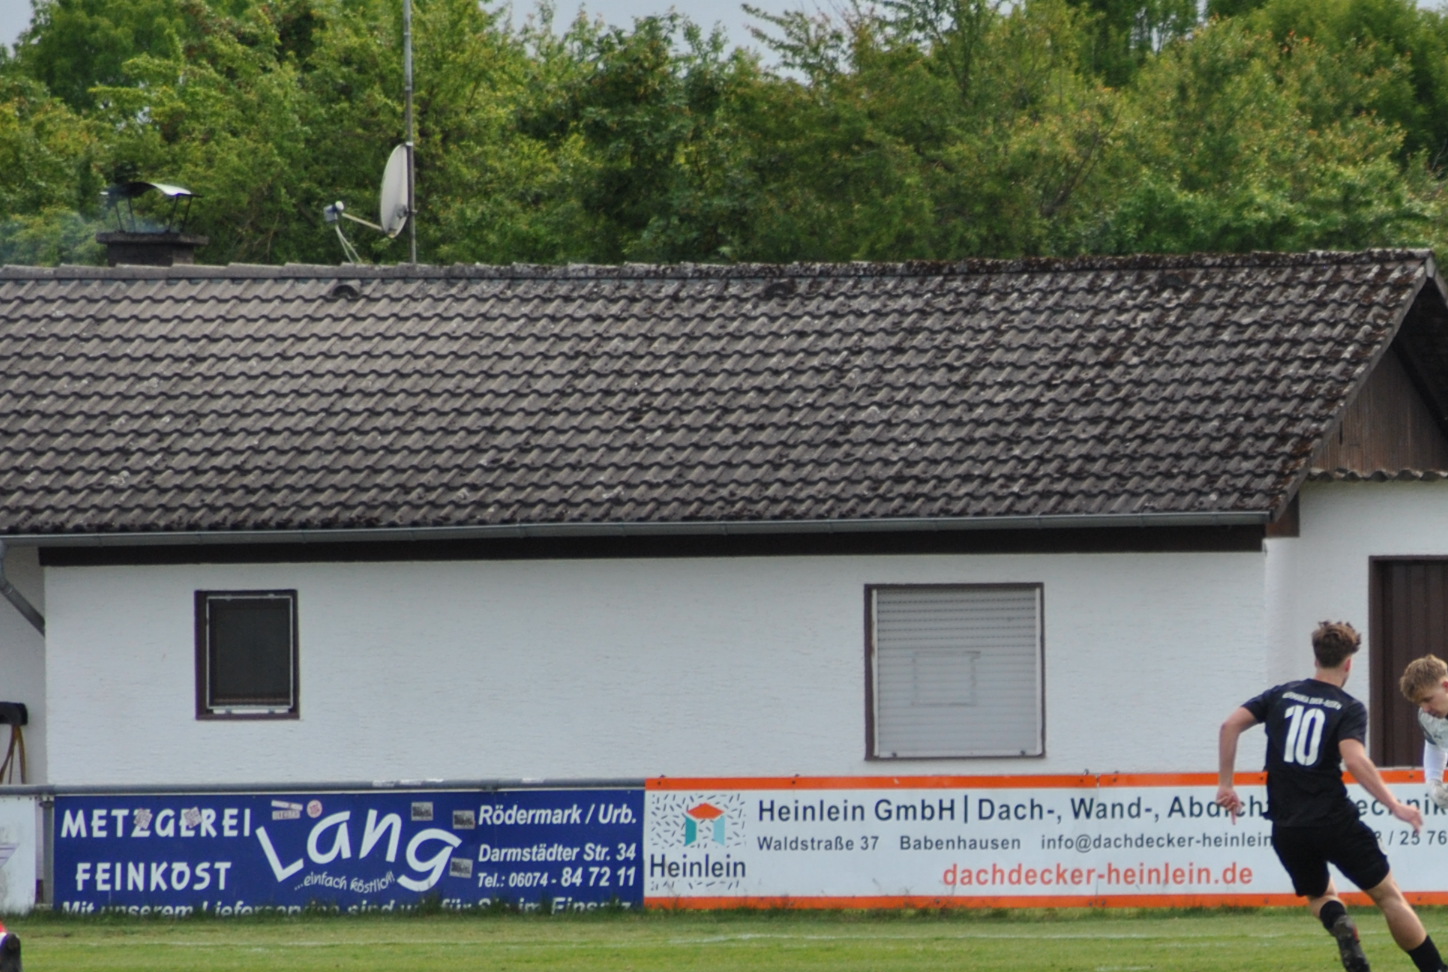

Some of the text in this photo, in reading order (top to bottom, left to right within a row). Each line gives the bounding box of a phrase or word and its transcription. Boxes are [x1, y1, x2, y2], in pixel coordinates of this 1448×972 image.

[1284, 705, 1325, 766] 10
[478, 804, 582, 825] Rödermark
[585, 804, 595, 824] /
[599, 804, 637, 824] Urb.
[758, 799, 865, 821] Heinlein
[874, 799, 955, 821] GmbH
[978, 797, 1062, 823] Dach-,
[1071, 796, 1159, 822] Wand-,
[60, 807, 251, 838] METZGEREI
[255, 809, 462, 892] Lang
[478, 843, 636, 862] Darmstädter Str. 34
[757, 835, 854, 851] Waldstraße
[860, 835, 879, 850] 37
[900, 835, 1021, 850] Babenhausen
[1041, 831, 1273, 853] info@dachdecker-heinlein
[1400, 830, 1420, 845] 25
[1427, 830, 1447, 845] 76
[75, 861, 232, 892] FEINKOST
[477, 872, 505, 888] Tel.:
[508, 872, 548, 888] 06074
[561, 867, 583, 887] 84
[589, 867, 610, 887] 72
[617, 866, 636, 886] 11
[650, 853, 746, 878] Heinlein
[943, 861, 1253, 885] dachdecker-heinlein.de
